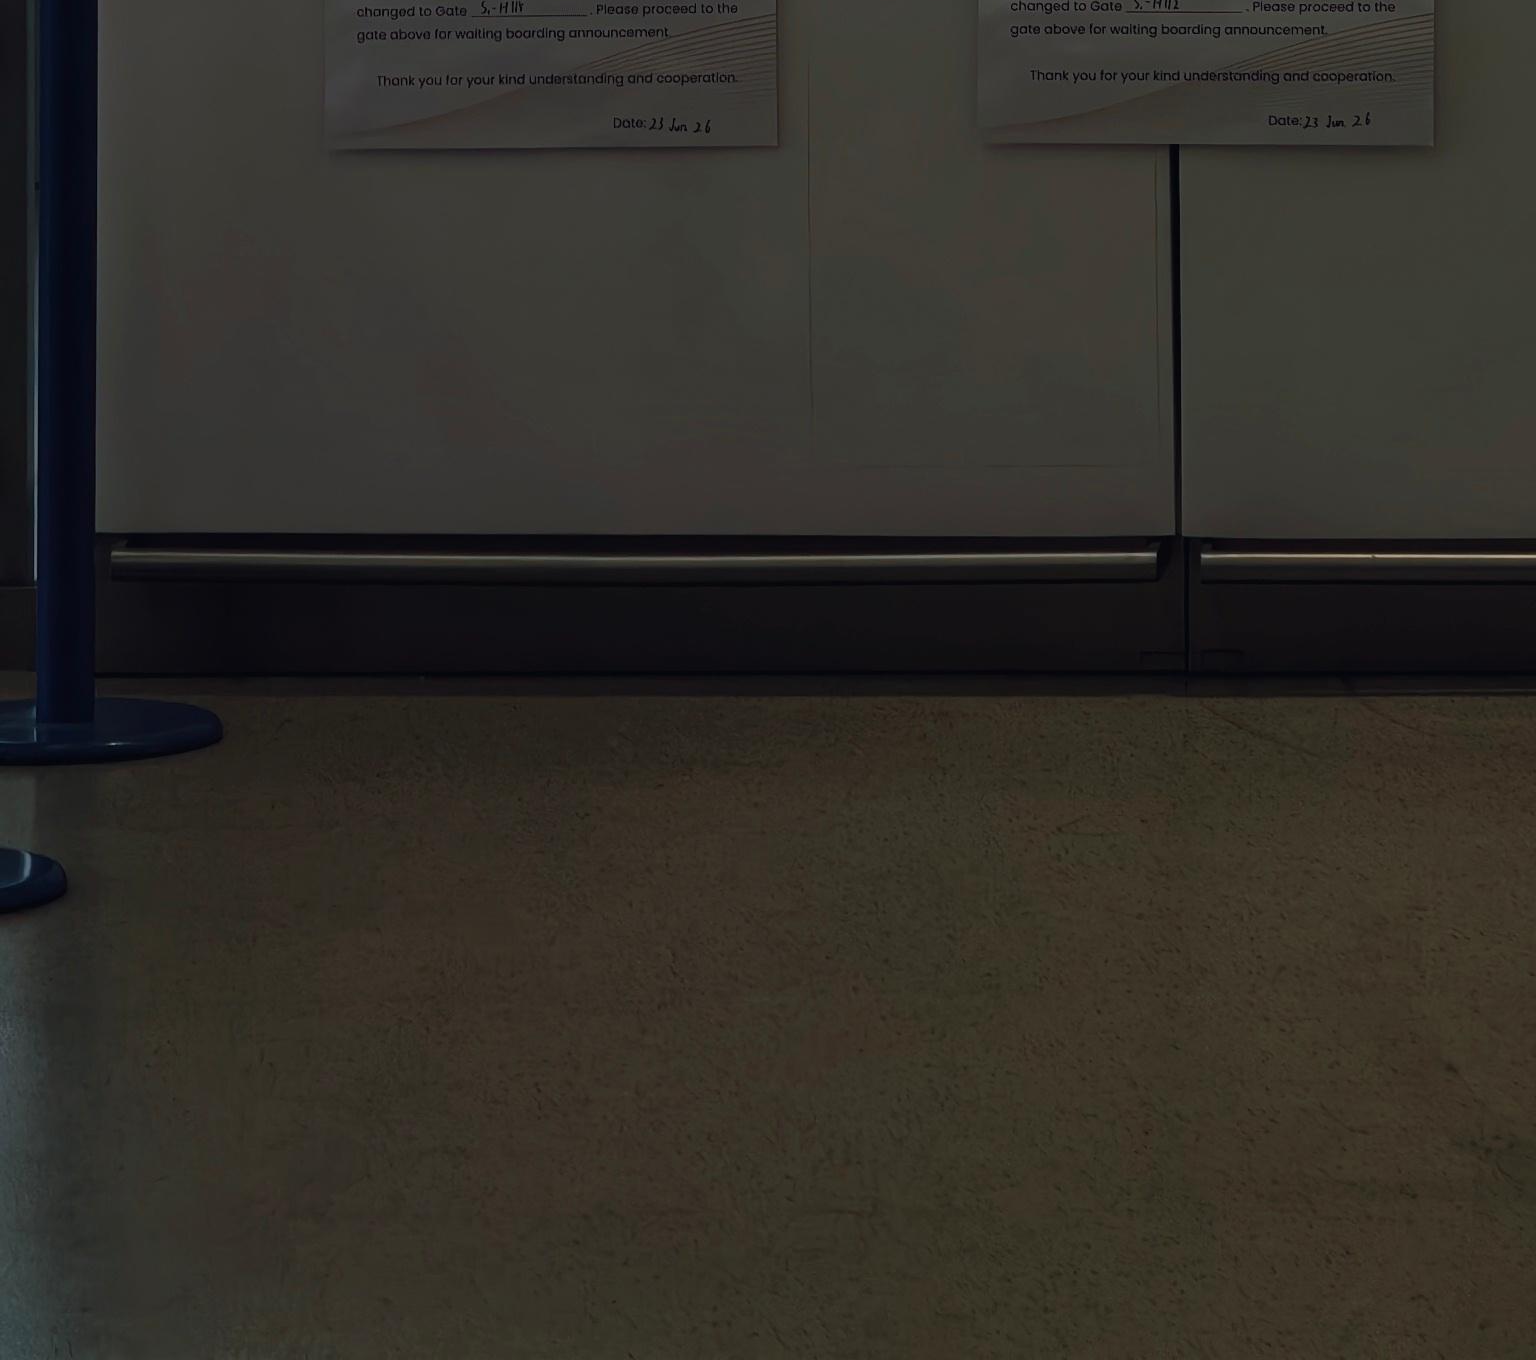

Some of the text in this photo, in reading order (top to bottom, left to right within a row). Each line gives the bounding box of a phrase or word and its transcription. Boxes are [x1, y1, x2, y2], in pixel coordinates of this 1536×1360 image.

[357, 3, 737, 20] changed to Gate Please proceed to the
[1011, 0, 1395, 15] changed to Gate Please proceed to the
[357, 28, 673, 43] gate above for waiting boarding announcement.
[1010, 24, 1328, 38] gate above for waiting boarding announcement.
[378, 72, 738, 88] Thank you for your kind understanding and cooperation.
[1030, 70, 1395, 84] Thank you for your kind understanding and cooperation.
[615, 117, 648, 130] Date:
[1269, 113, 1303, 126] Date:
